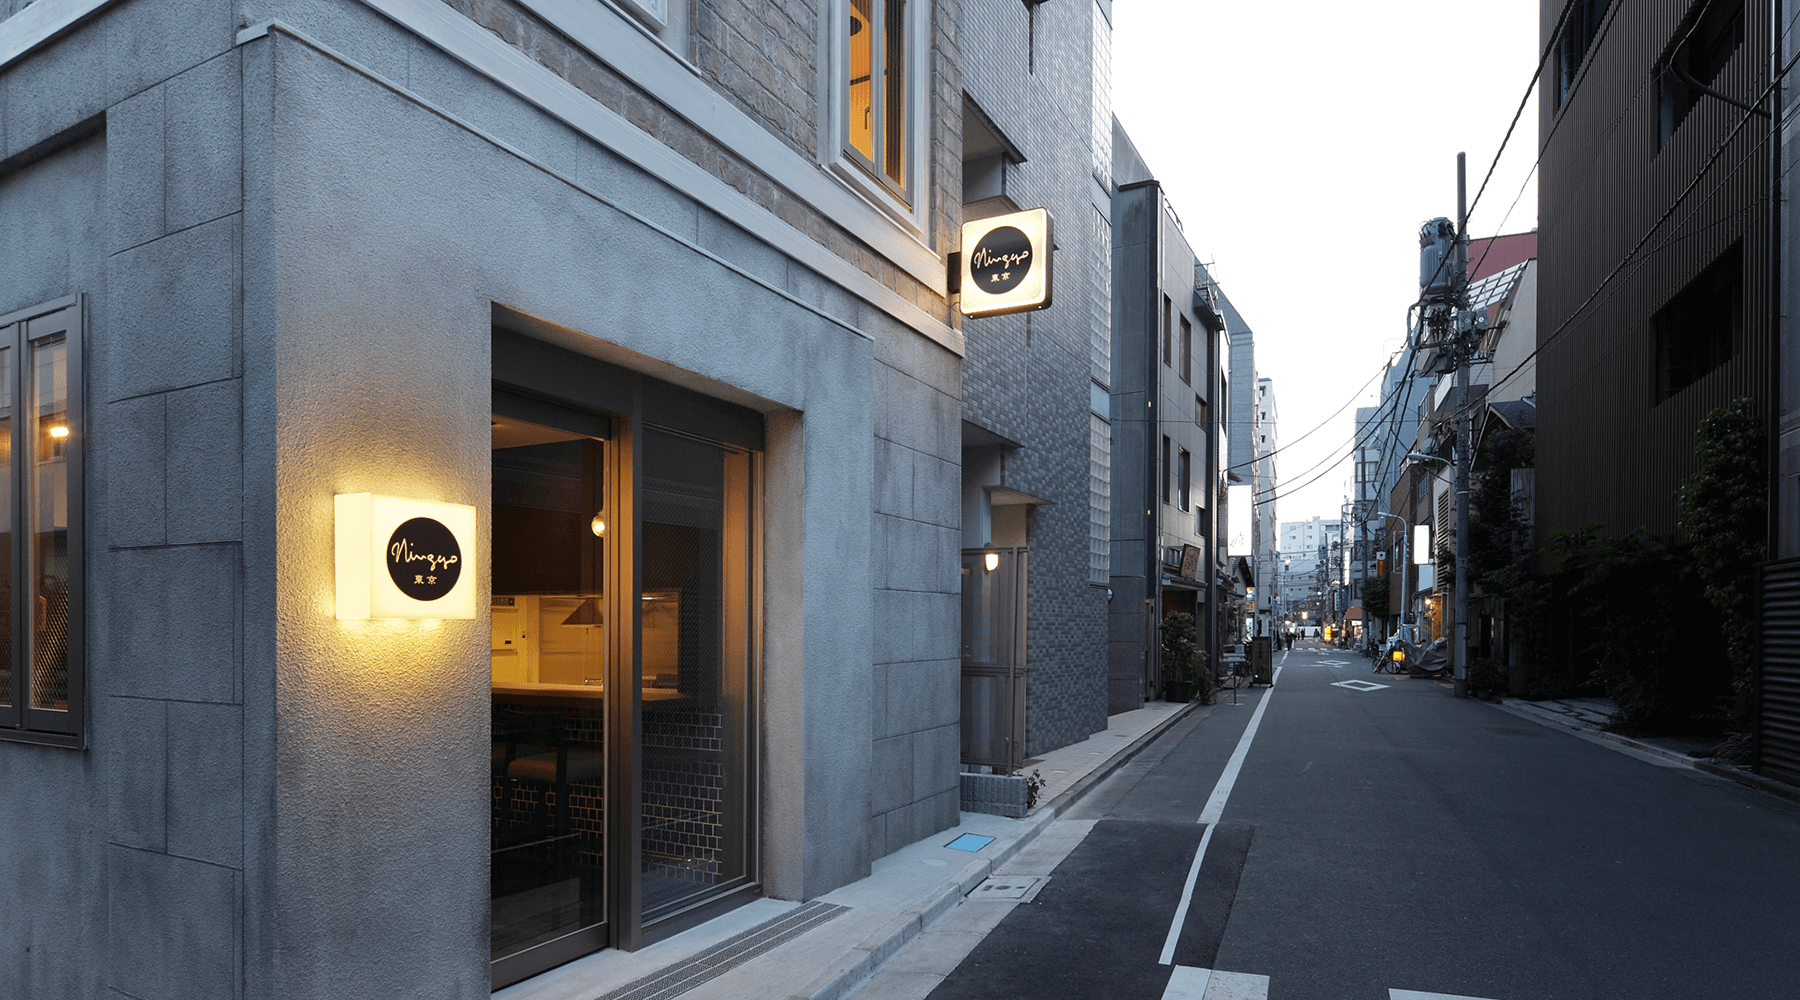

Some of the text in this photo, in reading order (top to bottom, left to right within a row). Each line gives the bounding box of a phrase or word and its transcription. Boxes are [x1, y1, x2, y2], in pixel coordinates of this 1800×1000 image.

[973, 247, 1029, 269] Ningyo
[990, 272, 1011, 282] 東京
[391, 538, 458, 571] Ningyo
[414, 574, 437, 585] 東京
